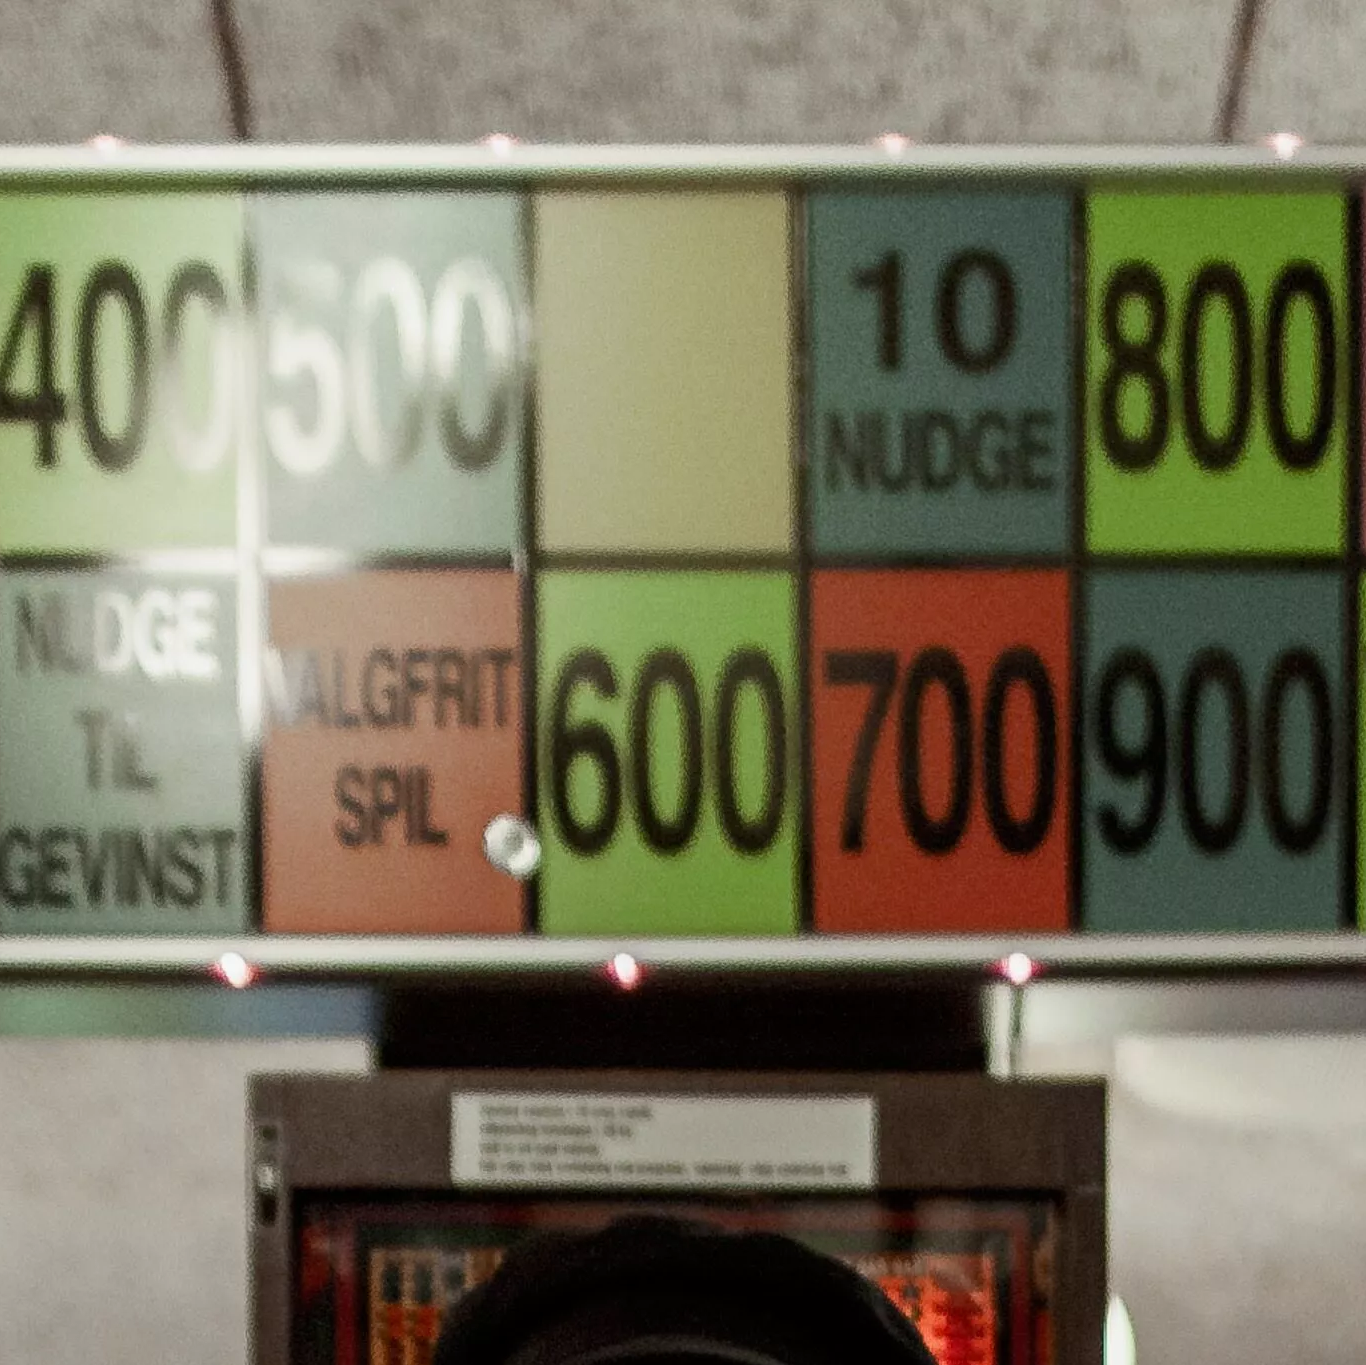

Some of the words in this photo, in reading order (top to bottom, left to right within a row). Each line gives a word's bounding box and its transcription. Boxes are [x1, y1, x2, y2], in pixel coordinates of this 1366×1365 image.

[262, 255, 515, 475] 500
[847, 248, 1017, 374] 10
[1098, 261, 1339, 472] 800
[825, 408, 1055, 492] NUDGE
[263, 645, 515, 730] VALGFRIT
[549, 647, 788, 858] 600
[824, 648, 1059, 858] 700
[1097, 647, 1341, 858] 900
[334, 763, 451, 850] SPIL
